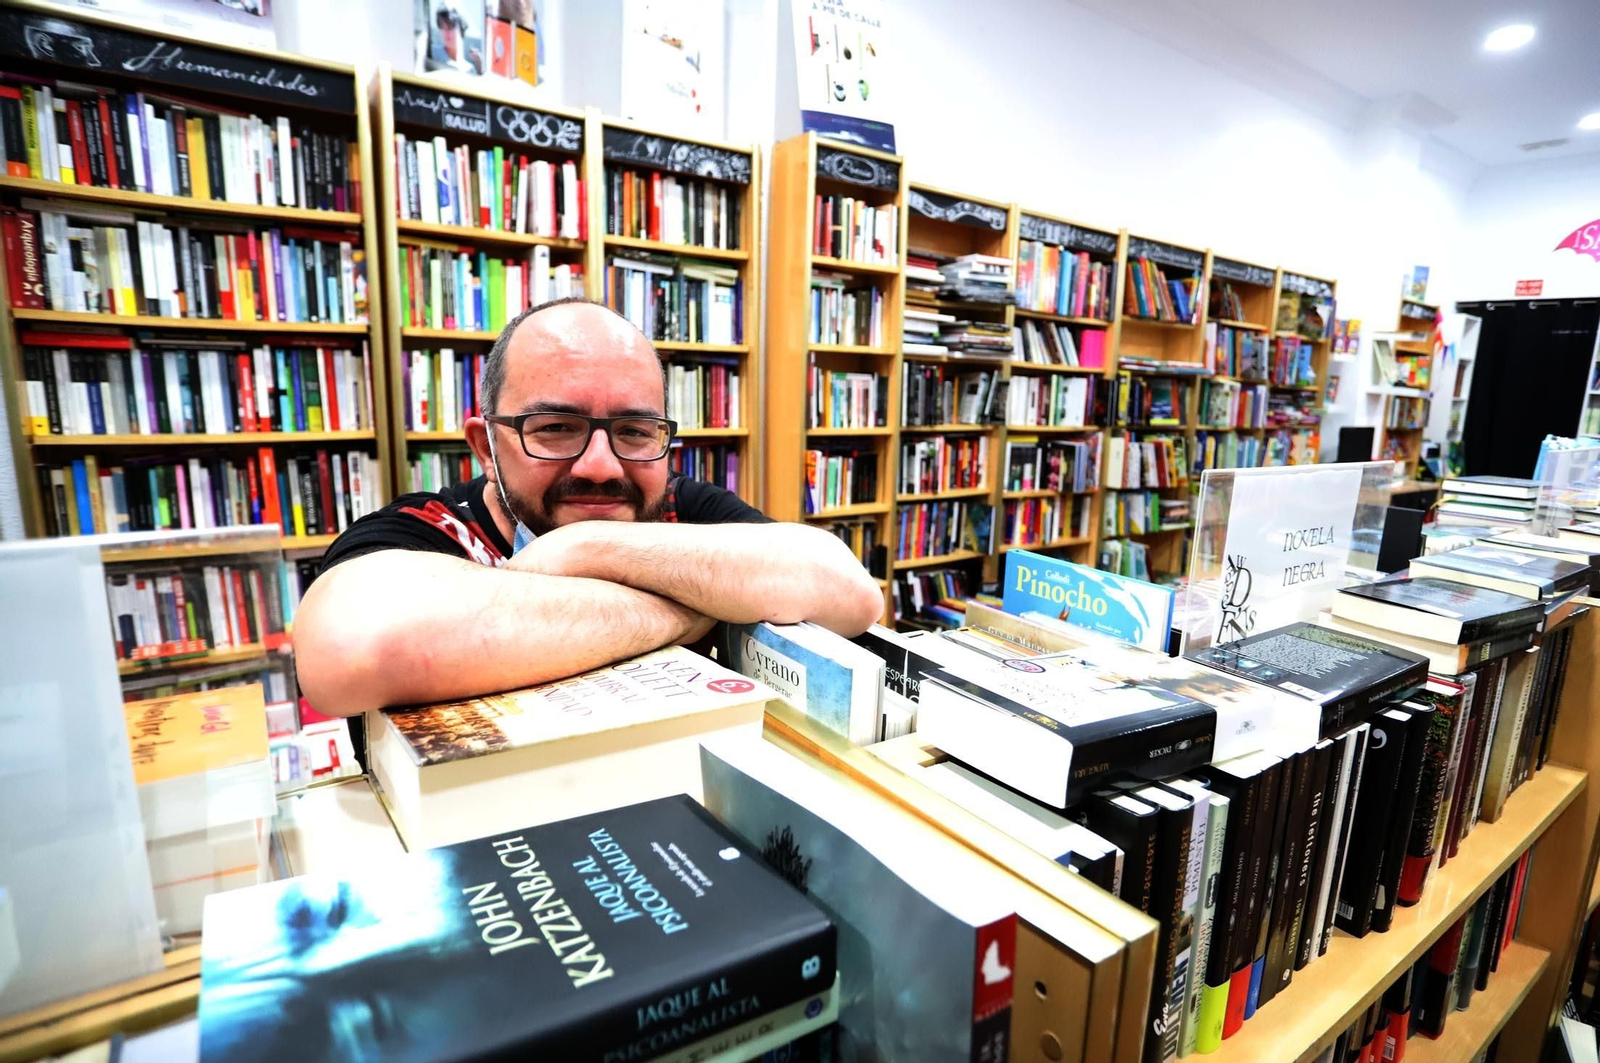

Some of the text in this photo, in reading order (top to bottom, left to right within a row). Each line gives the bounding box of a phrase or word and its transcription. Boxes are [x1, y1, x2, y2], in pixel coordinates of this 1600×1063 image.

[123, 42, 318, 97] Humanidades
[445, 113, 486, 134] SALUD
[1283, 526, 1335, 553] NOVELA
[1015, 565, 1108, 617] Pinocho
[1045, 569, 1072, 587] Collodi
[1282, 566, 1326, 587] NEGRA
[612, 662, 698, 697] OLLETT
[654, 660, 702, 683] KEN
[745, 637, 801, 687] Cyrano
[753, 668, 762, 680] de
[763, 674, 793, 701] Bergerac
[1149, 744, 1172, 758] DICKER
[1190, 817, 1208, 893] PIMENTEL
[1300, 791, 1321, 887] the leftovers
[572, 854, 644, 924] JAQUE AL
[587, 827, 689, 936] PSICOANALISTA
[462, 880, 541, 956] JOHN
[492, 834, 615, 990] KATZENBACH
[637, 954, 822, 1031] JAQUE AL B
[603, 995, 761, 1063] PSICOANALISTA
[1152, 1002, 1171, 1037] Eva
